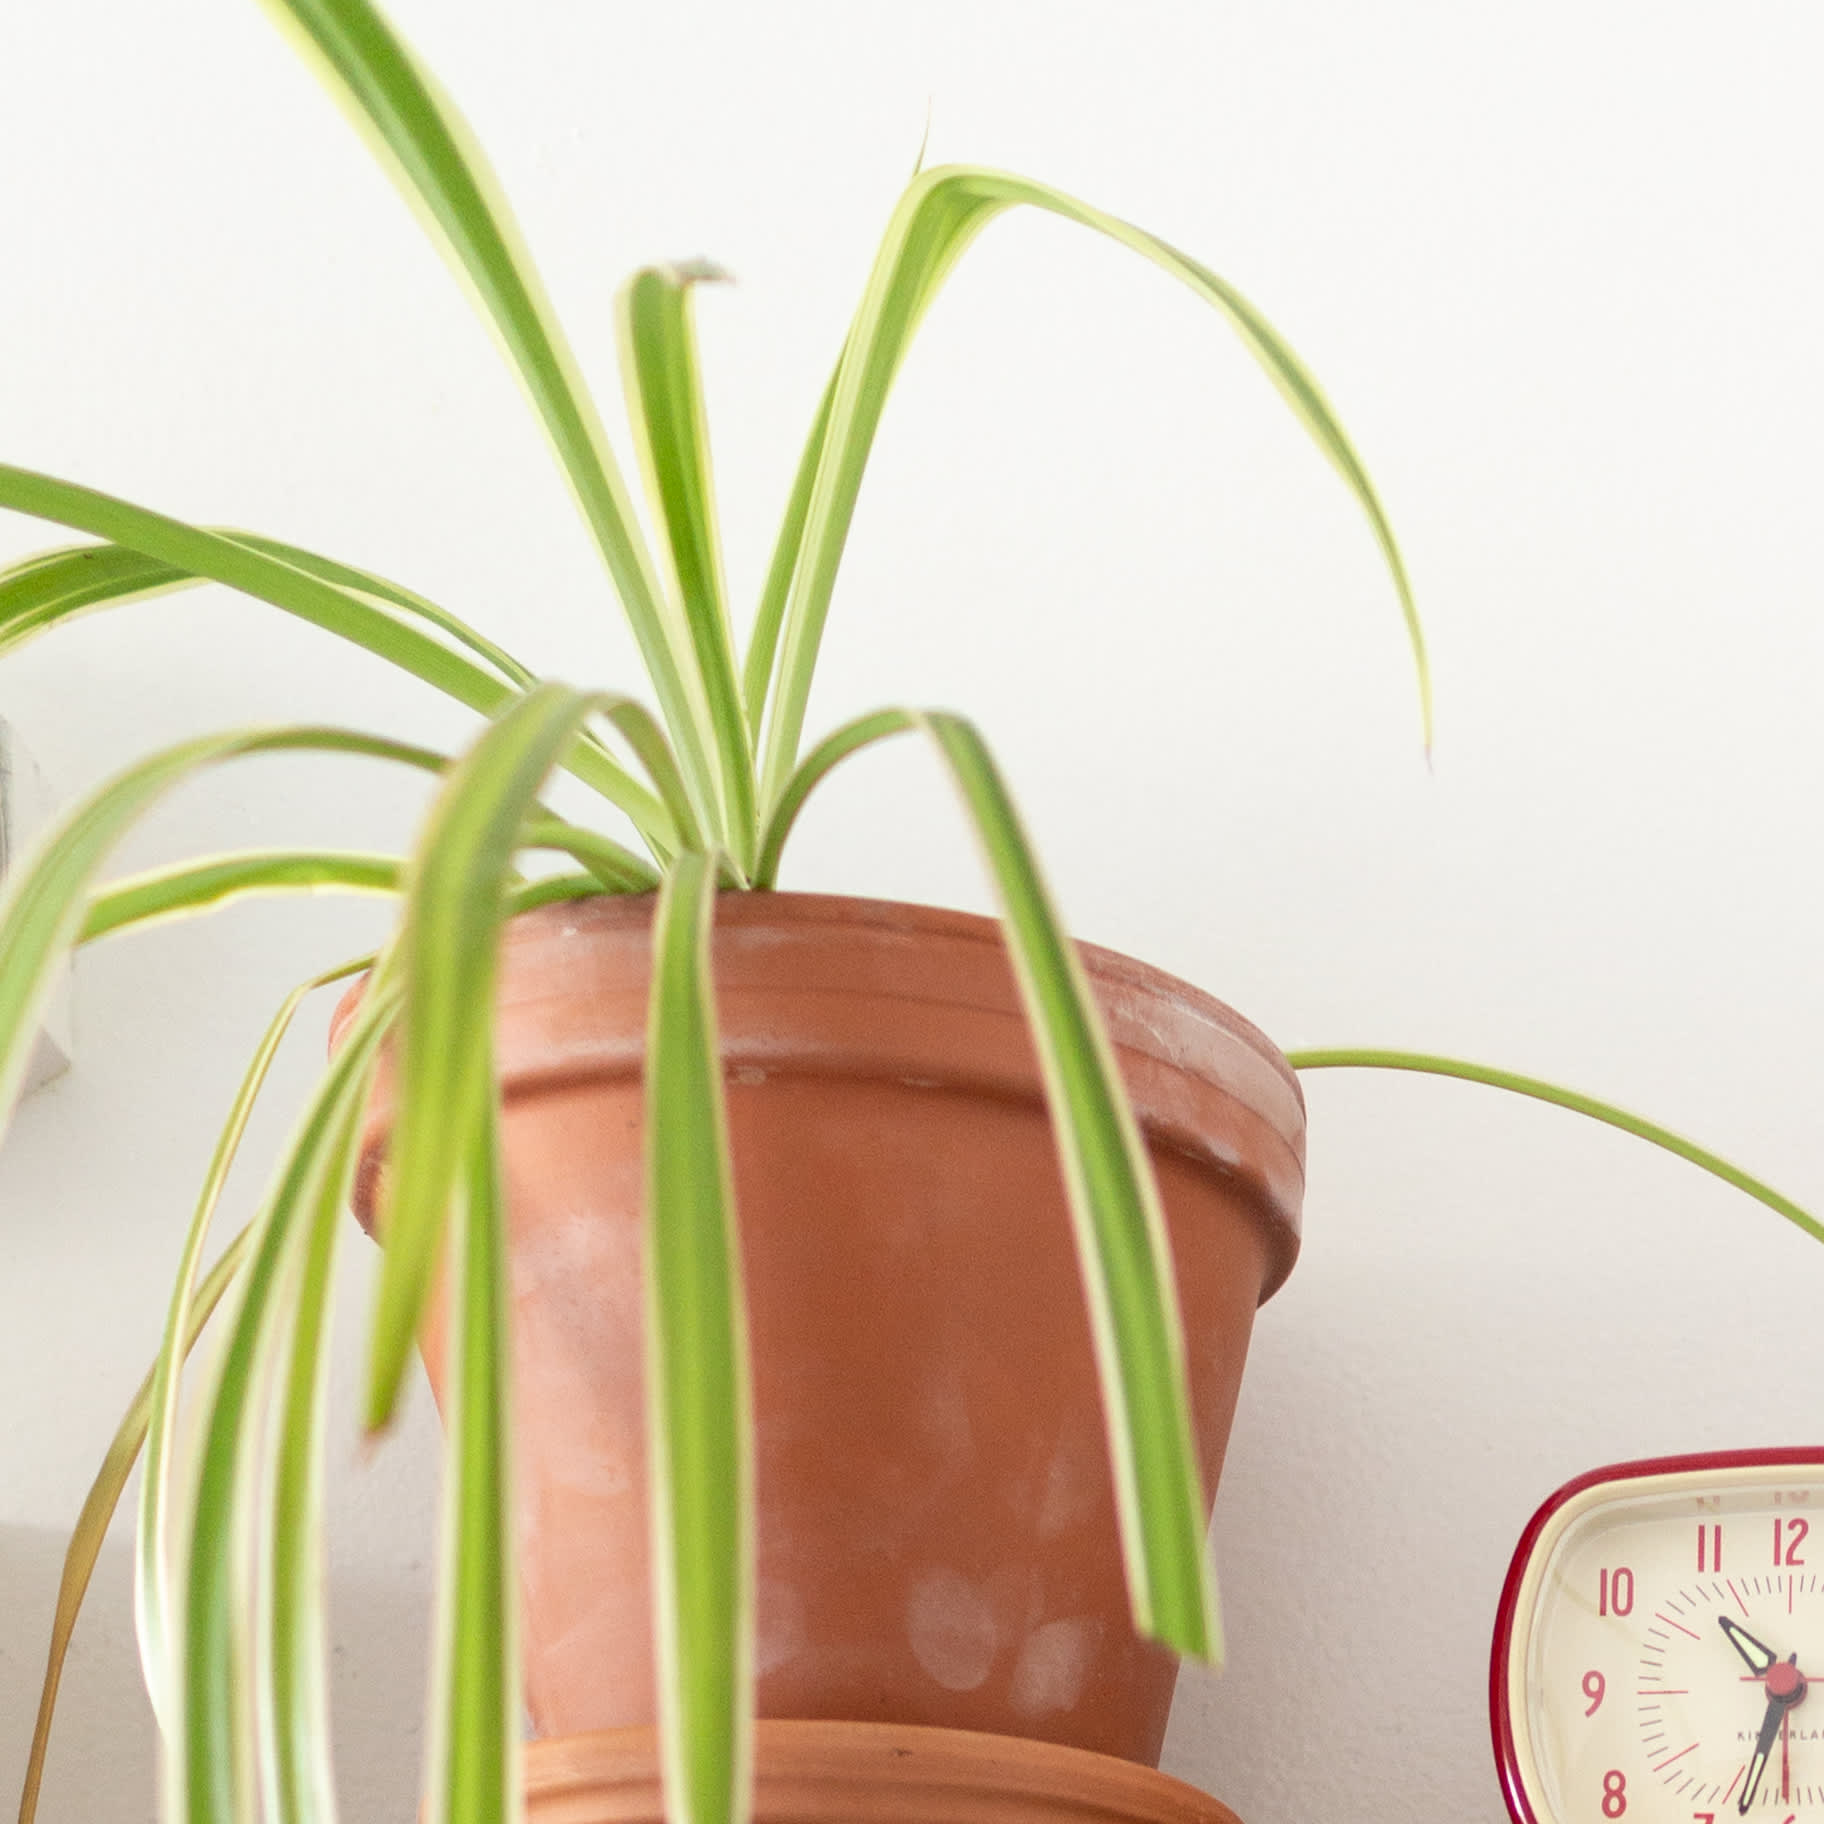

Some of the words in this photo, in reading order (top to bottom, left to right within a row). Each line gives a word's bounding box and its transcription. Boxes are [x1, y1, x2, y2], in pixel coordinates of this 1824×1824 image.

[1697, 1524, 1722, 1573] 11
[1773, 1517, 1809, 1567] 12
[1599, 1566, 1635, 1617] 10
[1581, 1669, 1606, 1717] 9
[1601, 1769, 1628, 1820] 8
